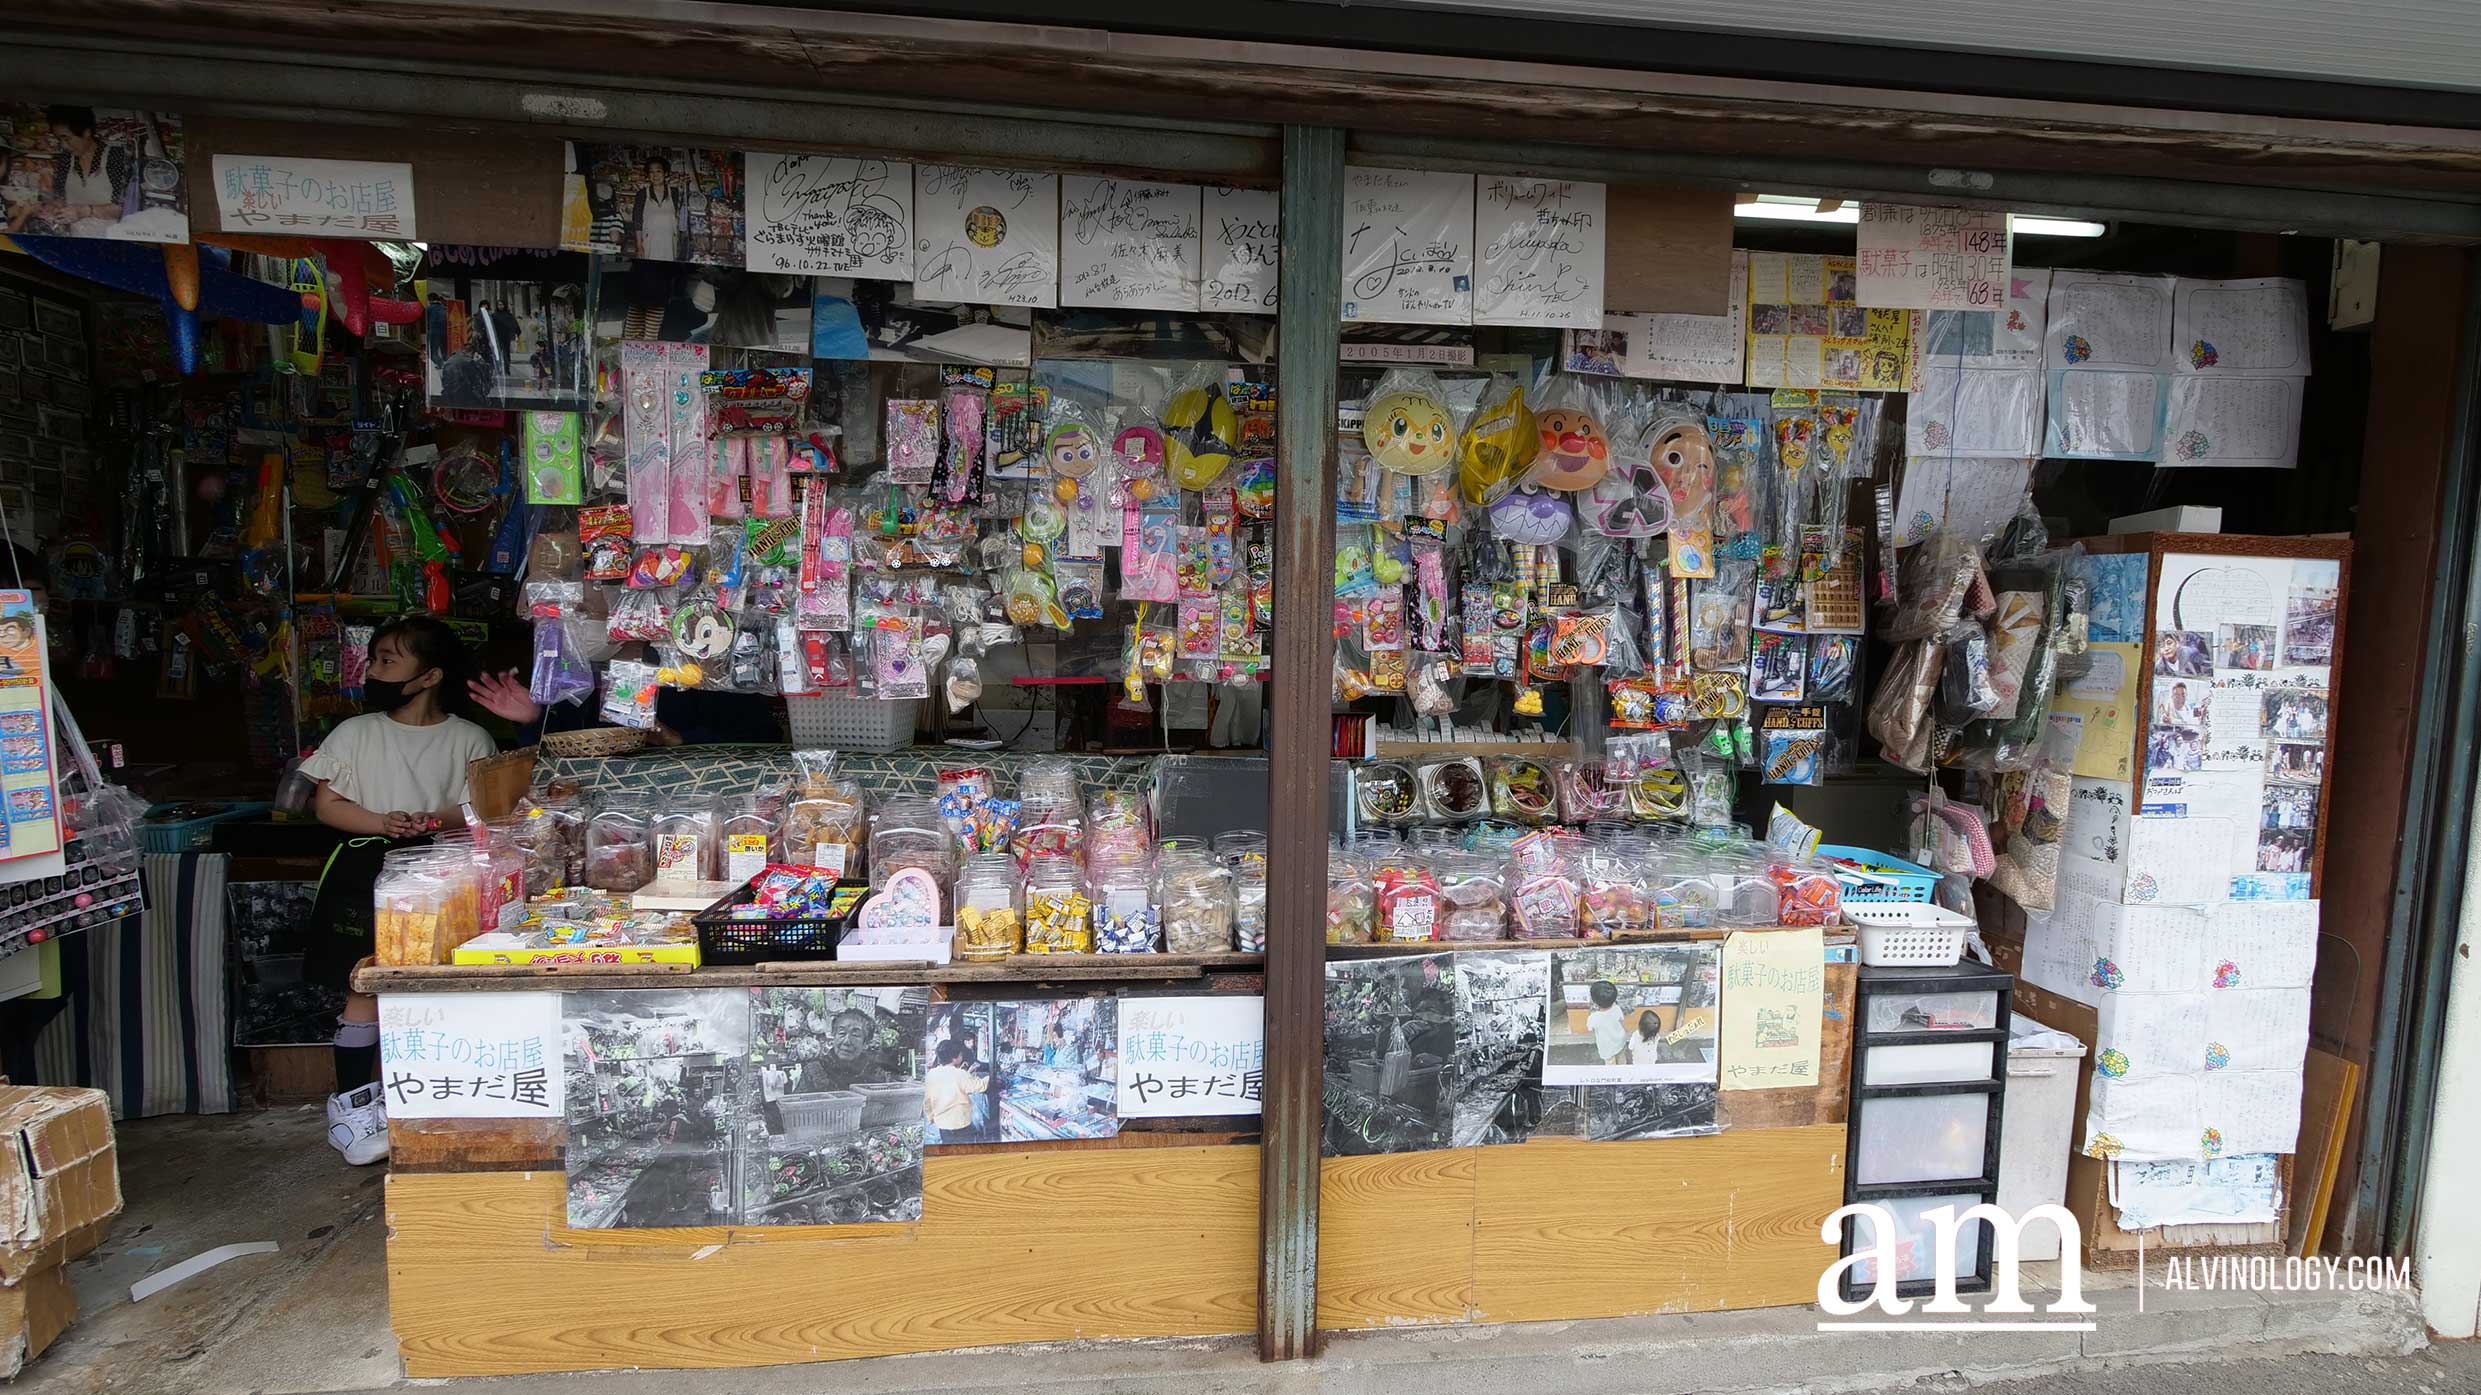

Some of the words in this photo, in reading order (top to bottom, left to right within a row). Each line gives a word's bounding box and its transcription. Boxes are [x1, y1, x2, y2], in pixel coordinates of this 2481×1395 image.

[225, 165, 399, 215] 駄菓子のお店屋
[243, 191, 282, 210] 楽しい
[230, 208, 402, 236] やまだ屋
[1737, 938, 1769, 955] 楽しい
[1727, 959, 1820, 995] 駄菓子のお店屋
[382, 1005, 446, 1028] 楽しい
[1128, 1009, 1184, 1031] 楽しい
[381, 1027, 545, 1072] 駄菓子のお店屋
[1728, 1059, 1809, 1078] やまだ屋
[387, 1067, 550, 1108] やまだ屋
